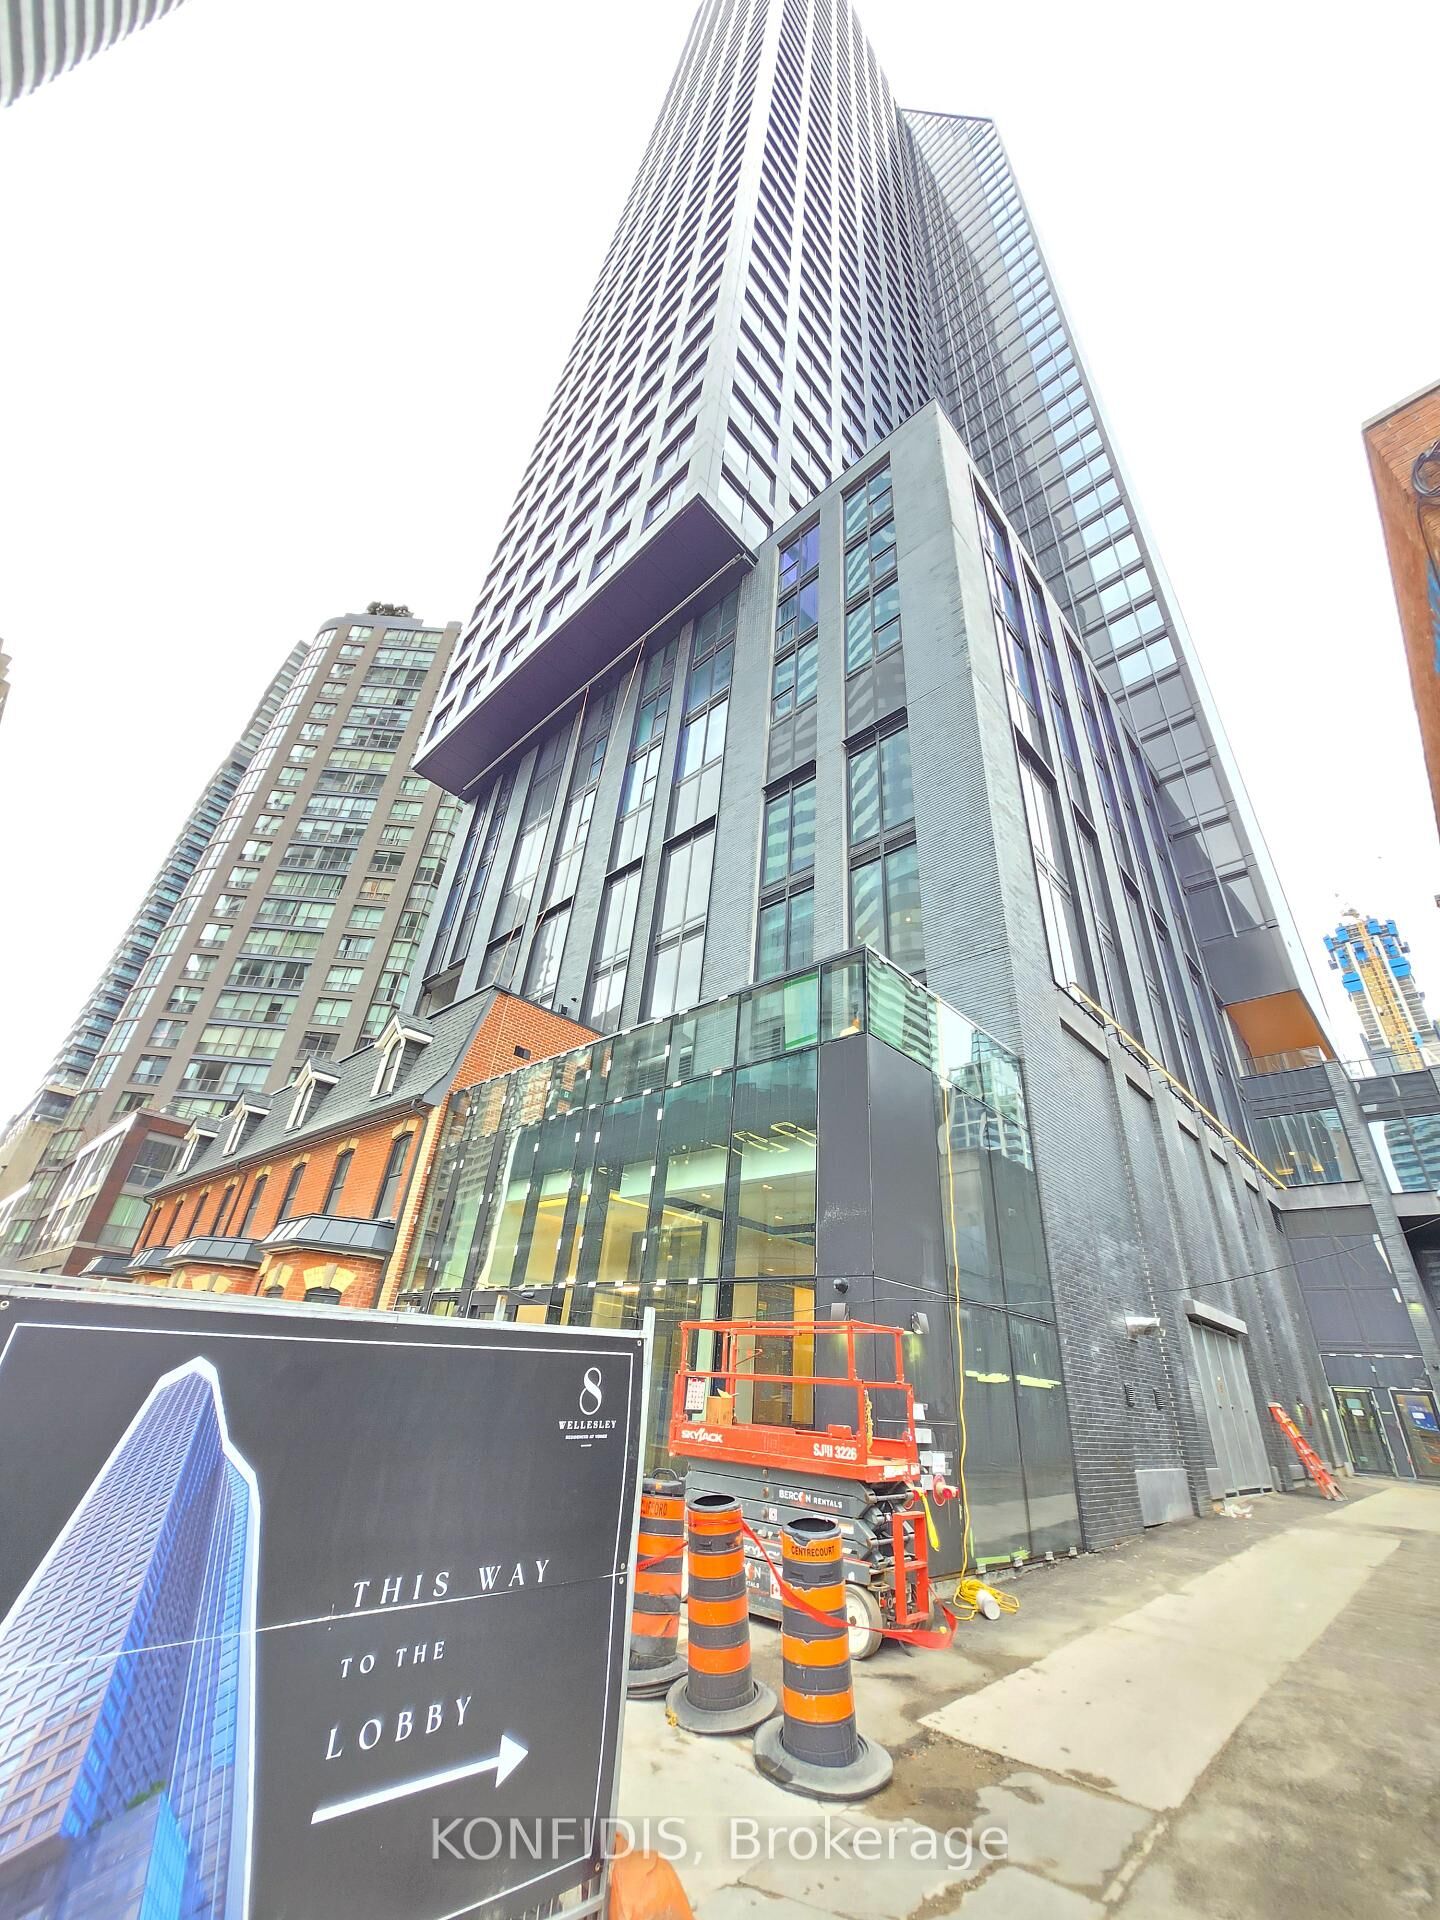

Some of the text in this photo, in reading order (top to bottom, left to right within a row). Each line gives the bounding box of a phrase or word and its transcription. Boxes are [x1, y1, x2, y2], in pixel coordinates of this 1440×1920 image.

[579, 1366, 602, 1415] 8
[558, 1420, 616, 1430] WELLESLEY
[681, 1428, 723, 1443] SKYJACK
[834, 1446, 857, 1460] 3226
[813, 1497, 843, 1509] RENTALS
[791, 1545, 835, 1557] CENTRECOURT
[353, 1560, 549, 1607] THIS WAY
[341, 1641, 445, 1678] TO THE
[325, 1696, 471, 1760] LOBBY
